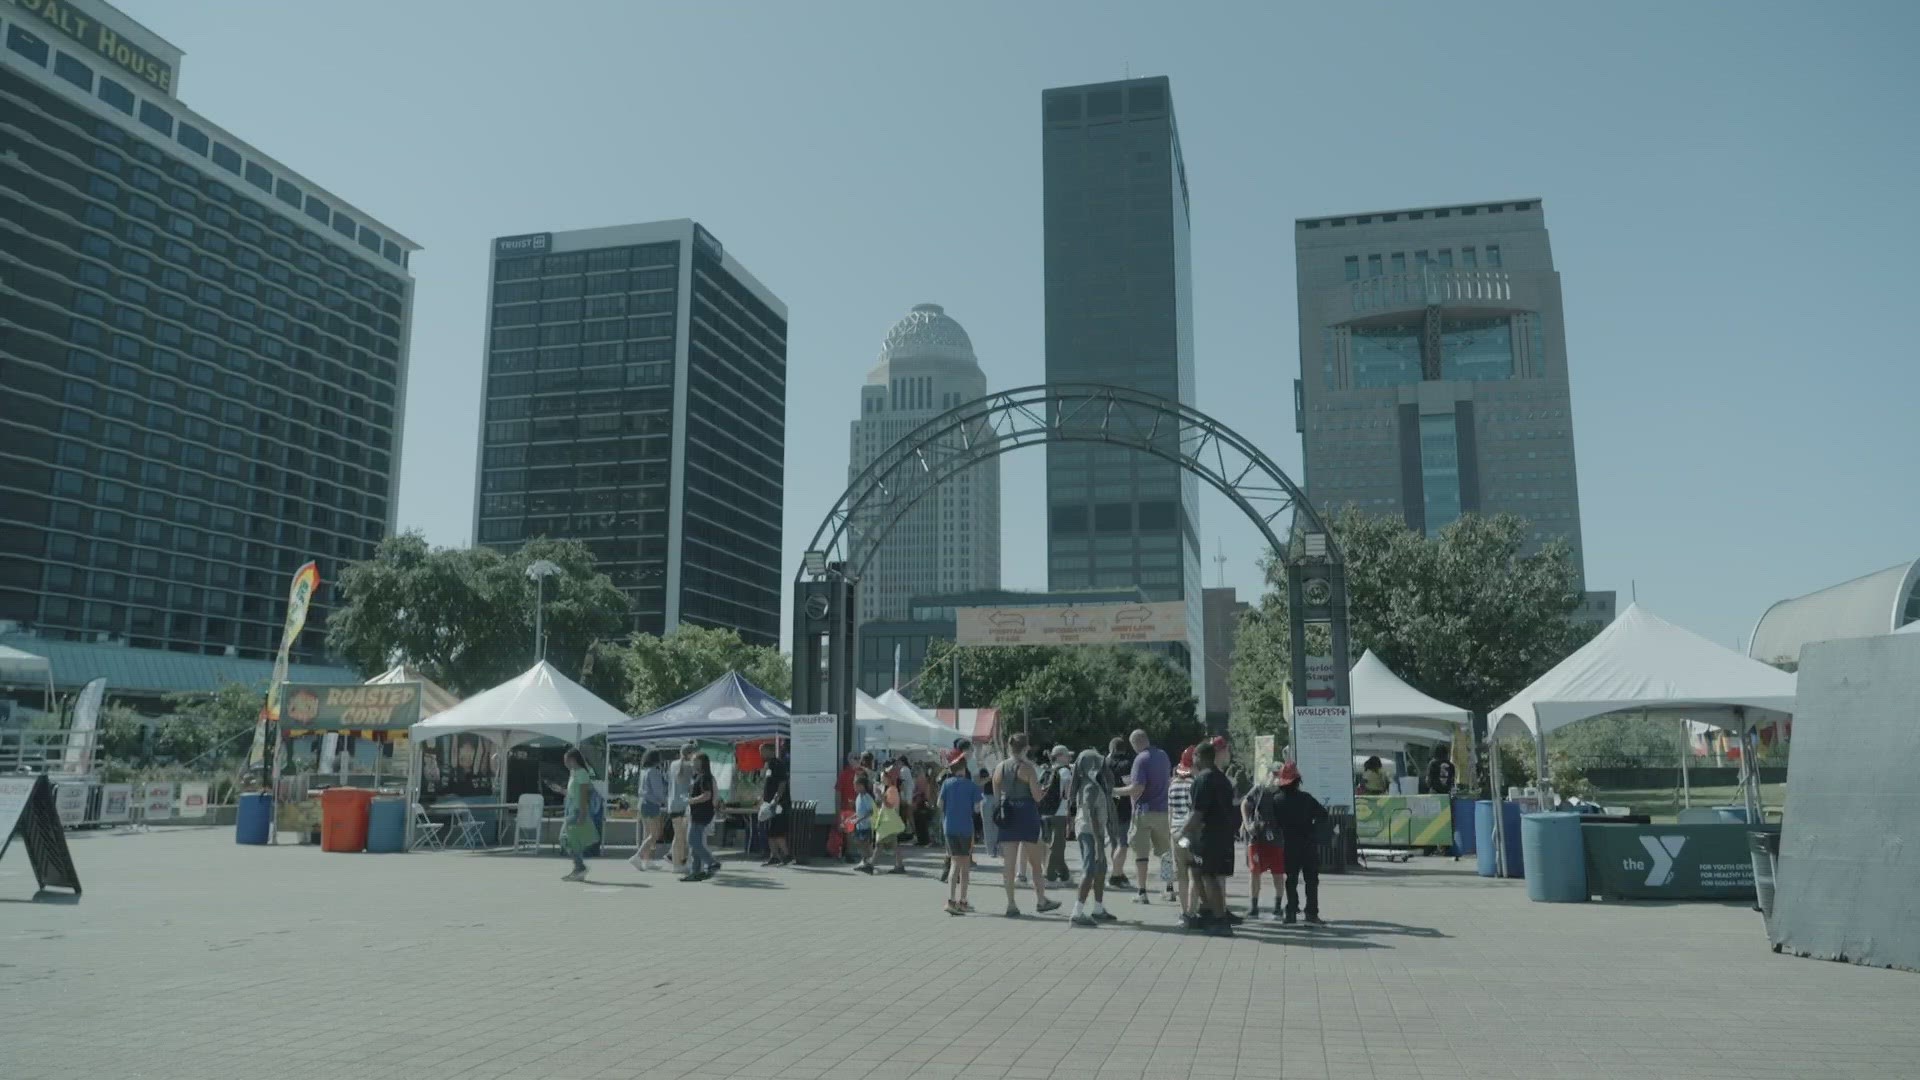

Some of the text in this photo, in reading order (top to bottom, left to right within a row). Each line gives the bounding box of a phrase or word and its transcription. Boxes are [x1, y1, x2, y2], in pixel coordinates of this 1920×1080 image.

[98, 26, 171, 90] HOUSE
[500, 239, 531, 249] TRUIST
[1306, 673, 1334, 681] Stage
[326, 687, 415, 705] ROASTED
[341, 706, 395, 725] CORN
[1297, 708, 1341, 717] WORLDFEST
[1623, 858, 1645, 870] the
[1639, 835, 1686, 886] Y
